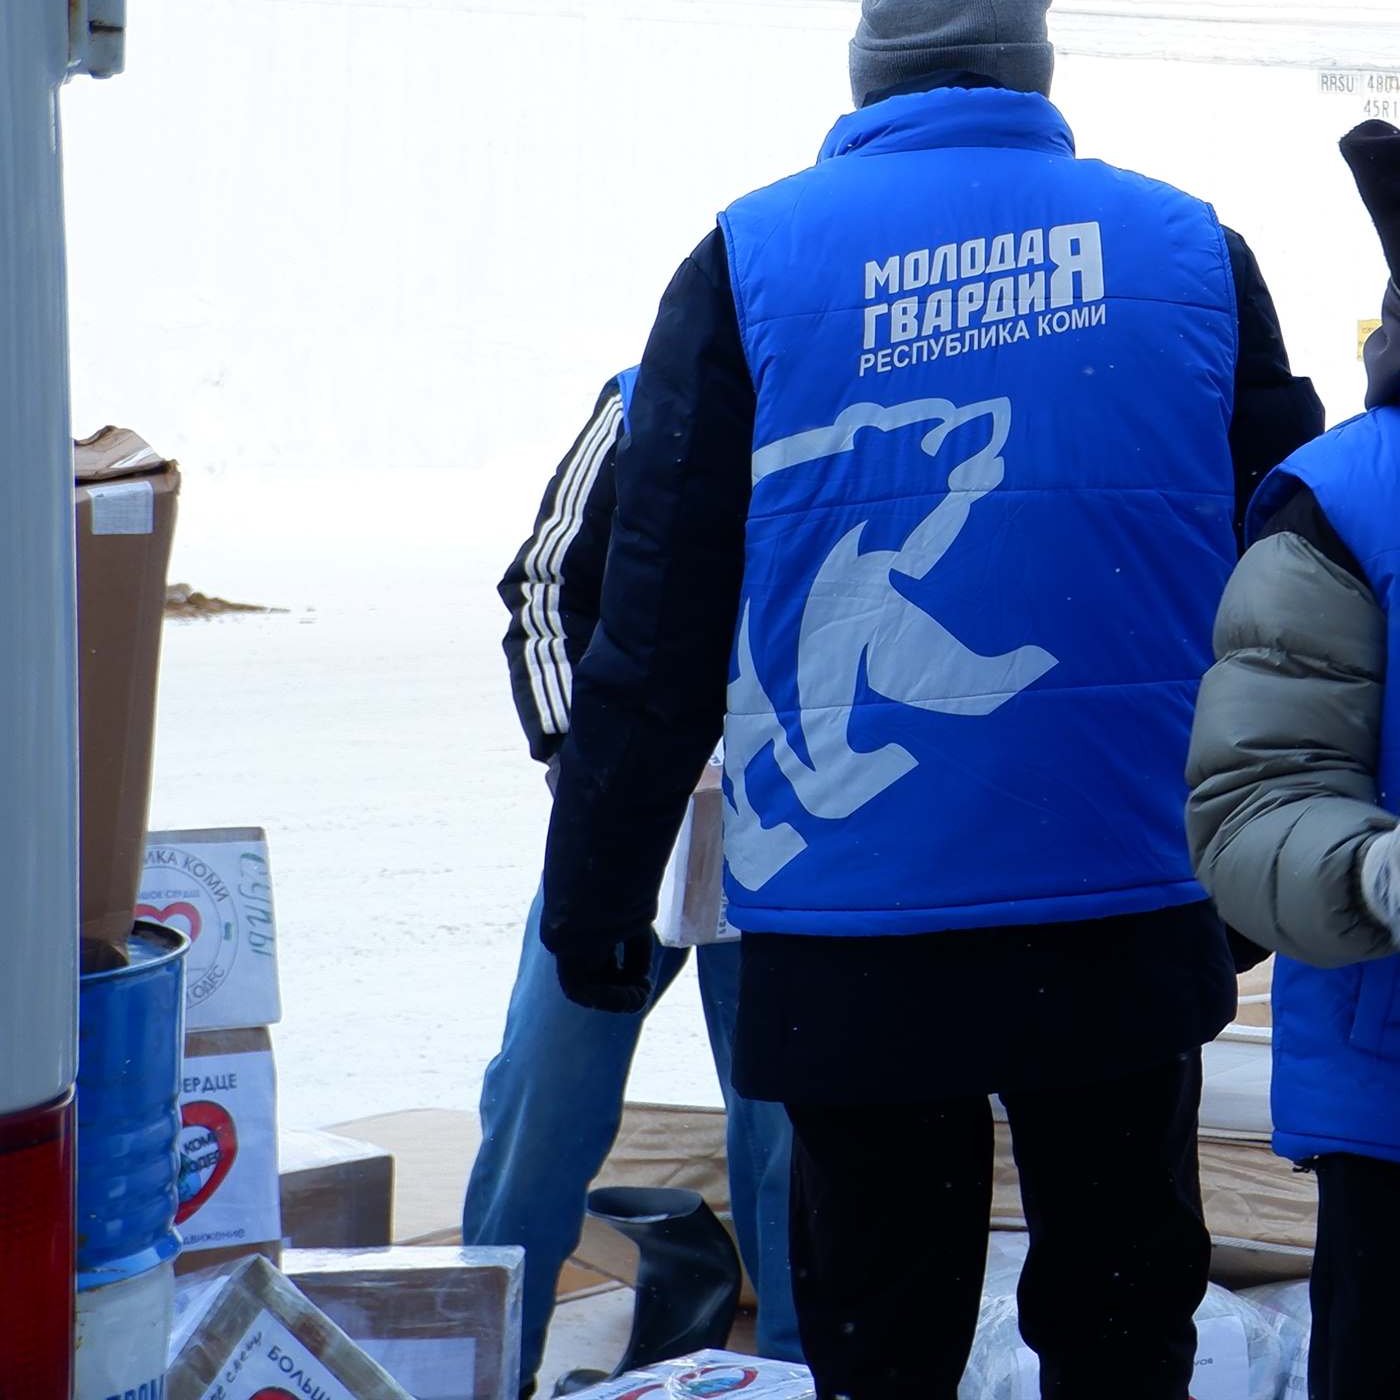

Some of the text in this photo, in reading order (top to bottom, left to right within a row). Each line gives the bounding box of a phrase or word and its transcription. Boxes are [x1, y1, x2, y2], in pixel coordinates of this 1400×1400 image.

[864, 221, 1105, 302] МОЛОДАЯ
[859, 304, 1106, 377] РЕСПУБЛИКА КОМИ
[183, 855, 229, 903] КОМИ
[183, 1073, 238, 1094] ЕРДЦЕ
